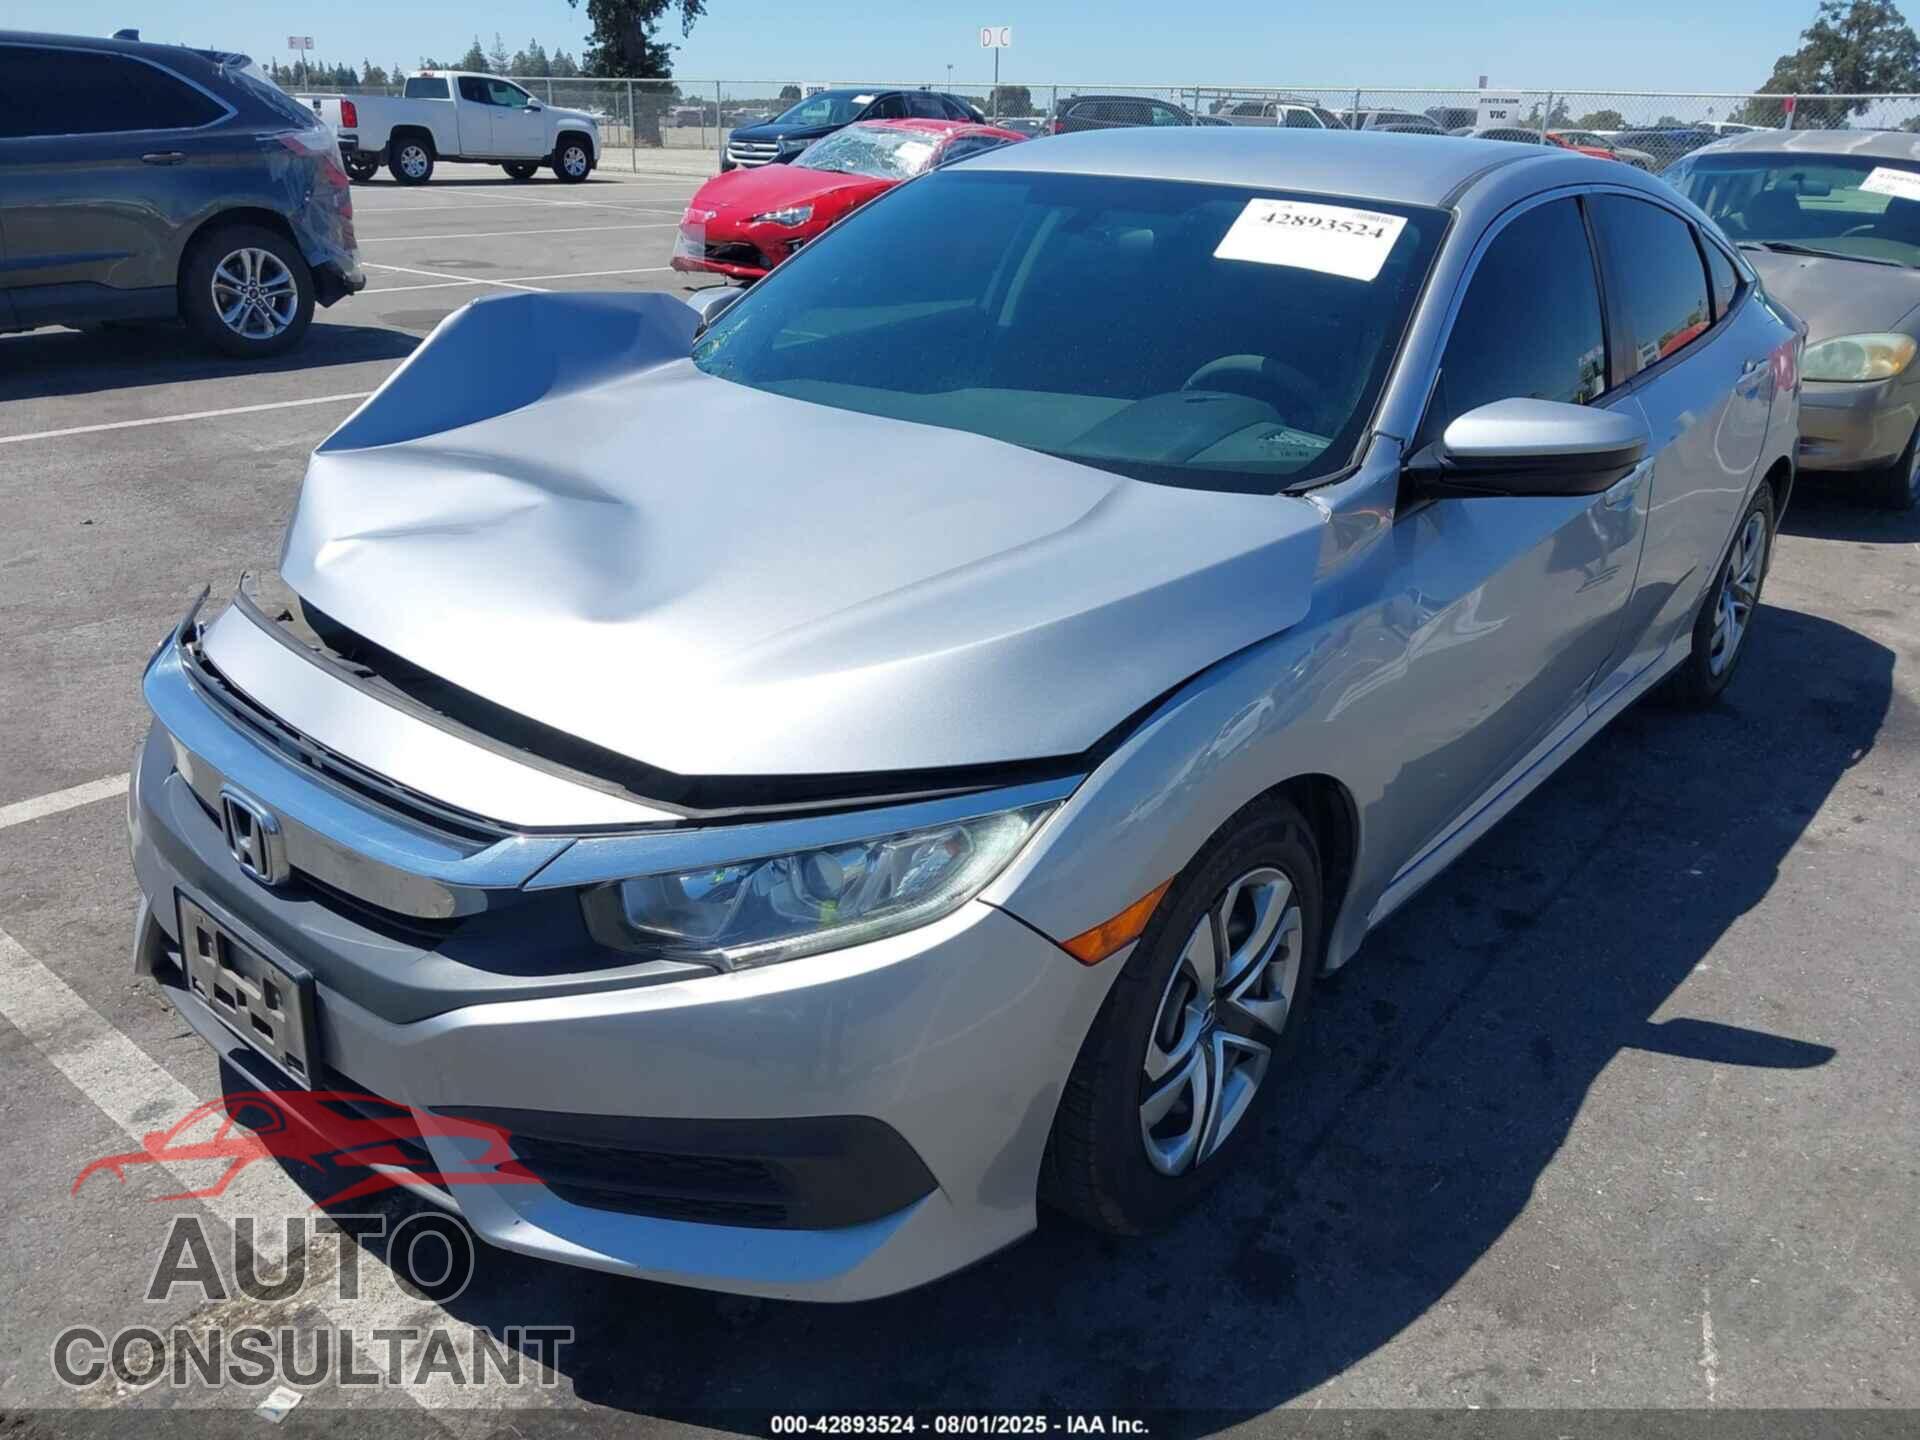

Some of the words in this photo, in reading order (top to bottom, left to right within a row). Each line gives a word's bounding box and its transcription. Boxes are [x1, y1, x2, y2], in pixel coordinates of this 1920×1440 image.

[982, 28, 992, 47] D
[1000, 28, 1009, 47] C
[1489, 110, 1507, 120] VIC
[1260, 212, 1385, 239] 42893524
